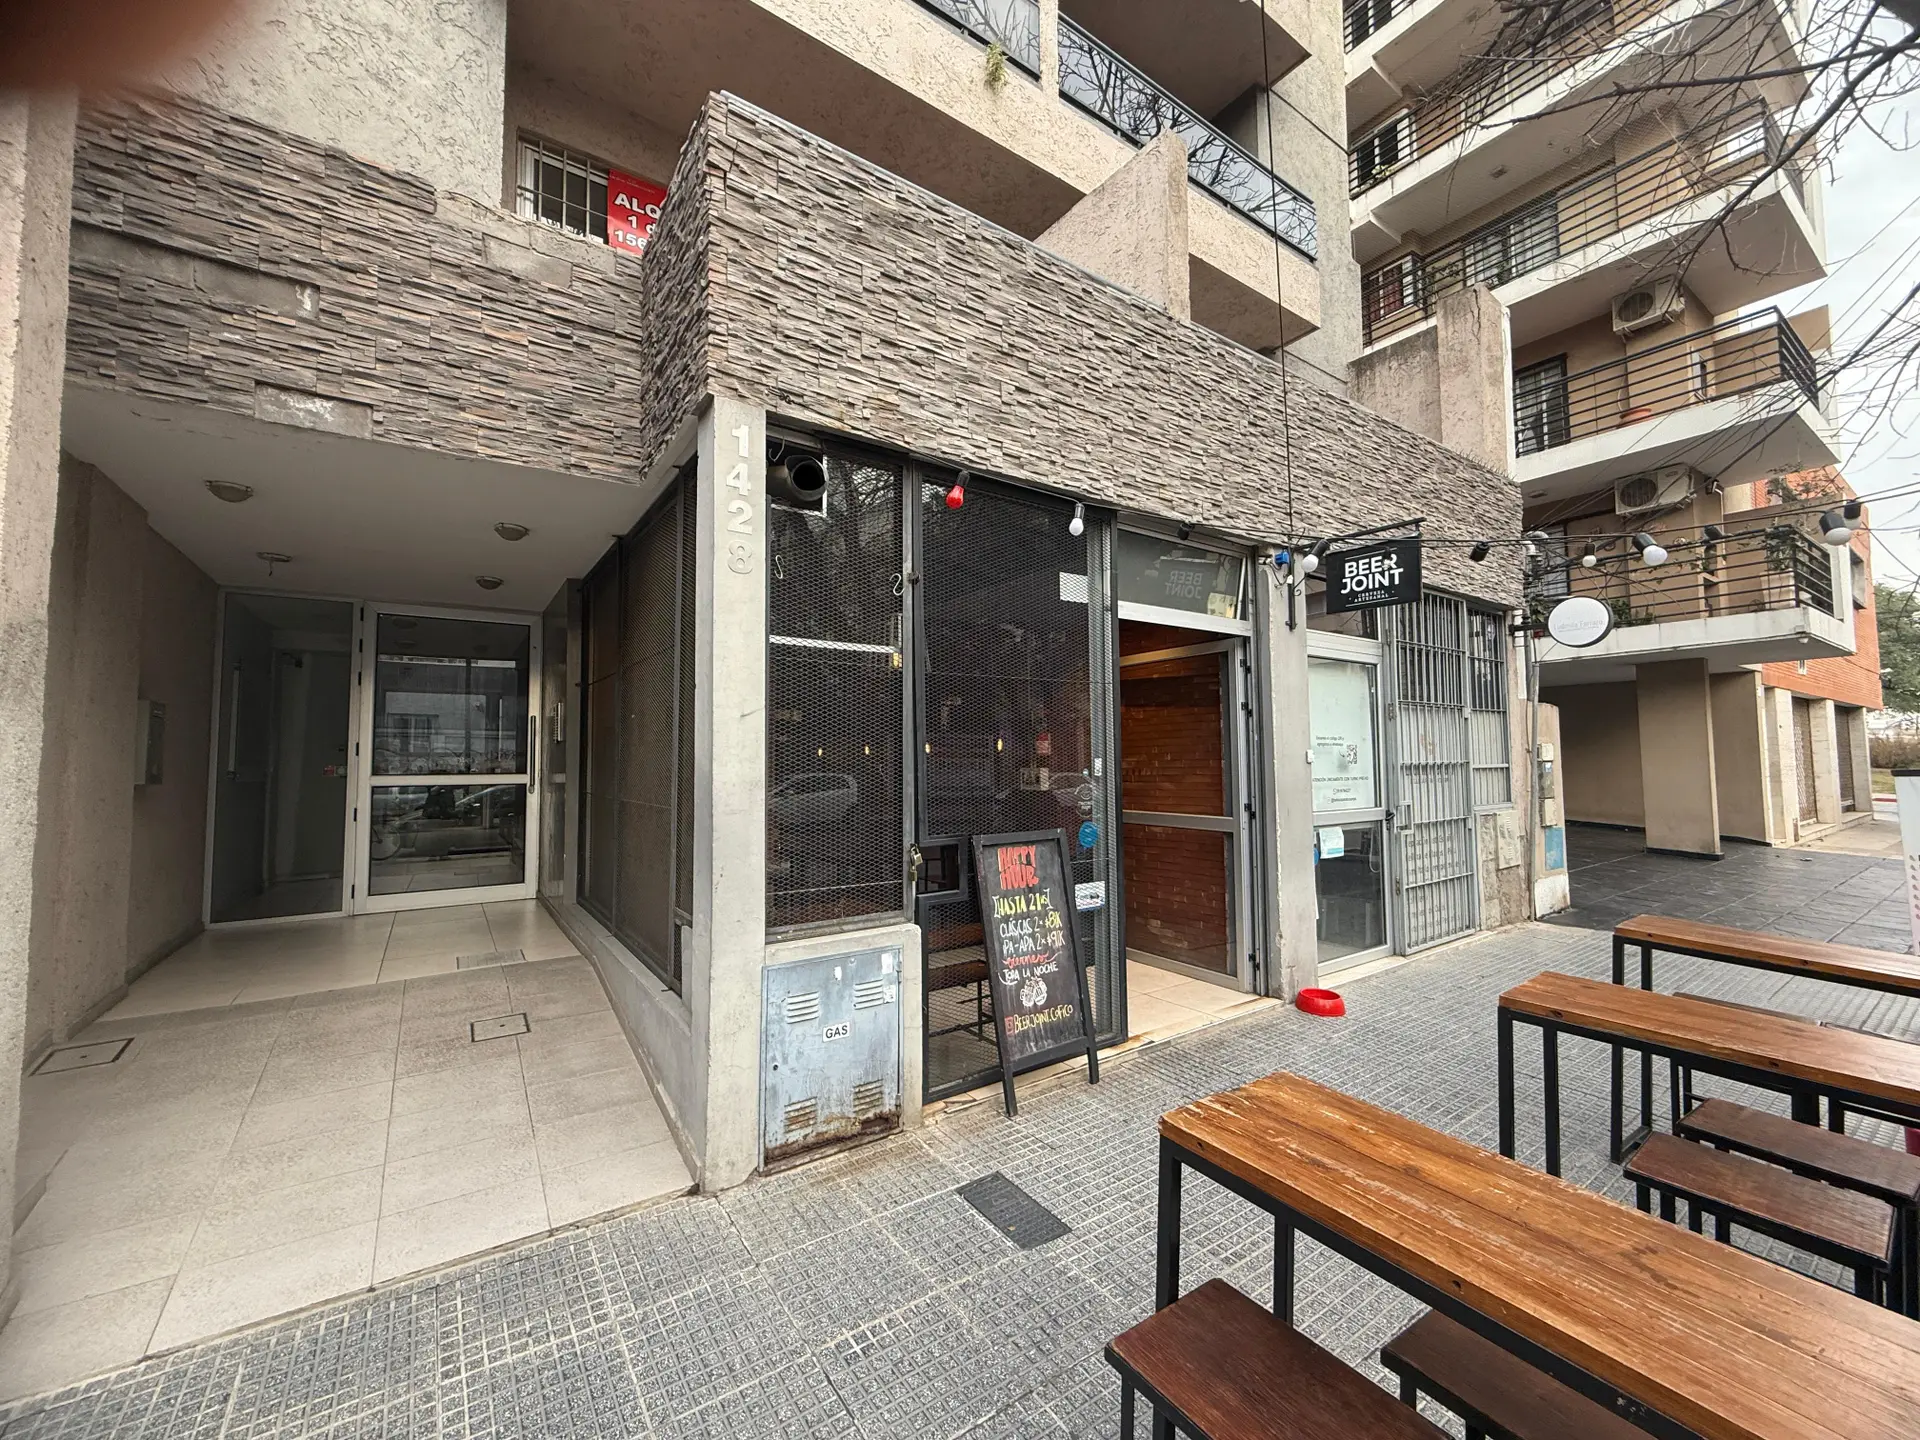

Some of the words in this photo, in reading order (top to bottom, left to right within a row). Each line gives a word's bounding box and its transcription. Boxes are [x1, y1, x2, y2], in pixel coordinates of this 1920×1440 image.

[614, 192, 667, 219] ALQ
[627, 215, 637, 229] 1
[726, 424, 753, 574] 1428
[1344, 553, 1398, 578] BEER
[1340, 567, 1404, 594] JOINT
[998, 845, 1036, 872] HAPPY
[1000, 864, 1039, 890] HOUR
[1003, 969, 1020, 981] TODA
[1022, 967, 1031, 978] LA
[1034, 961, 1059, 977] NOCHE
[825, 1024, 848, 1039] GAS
